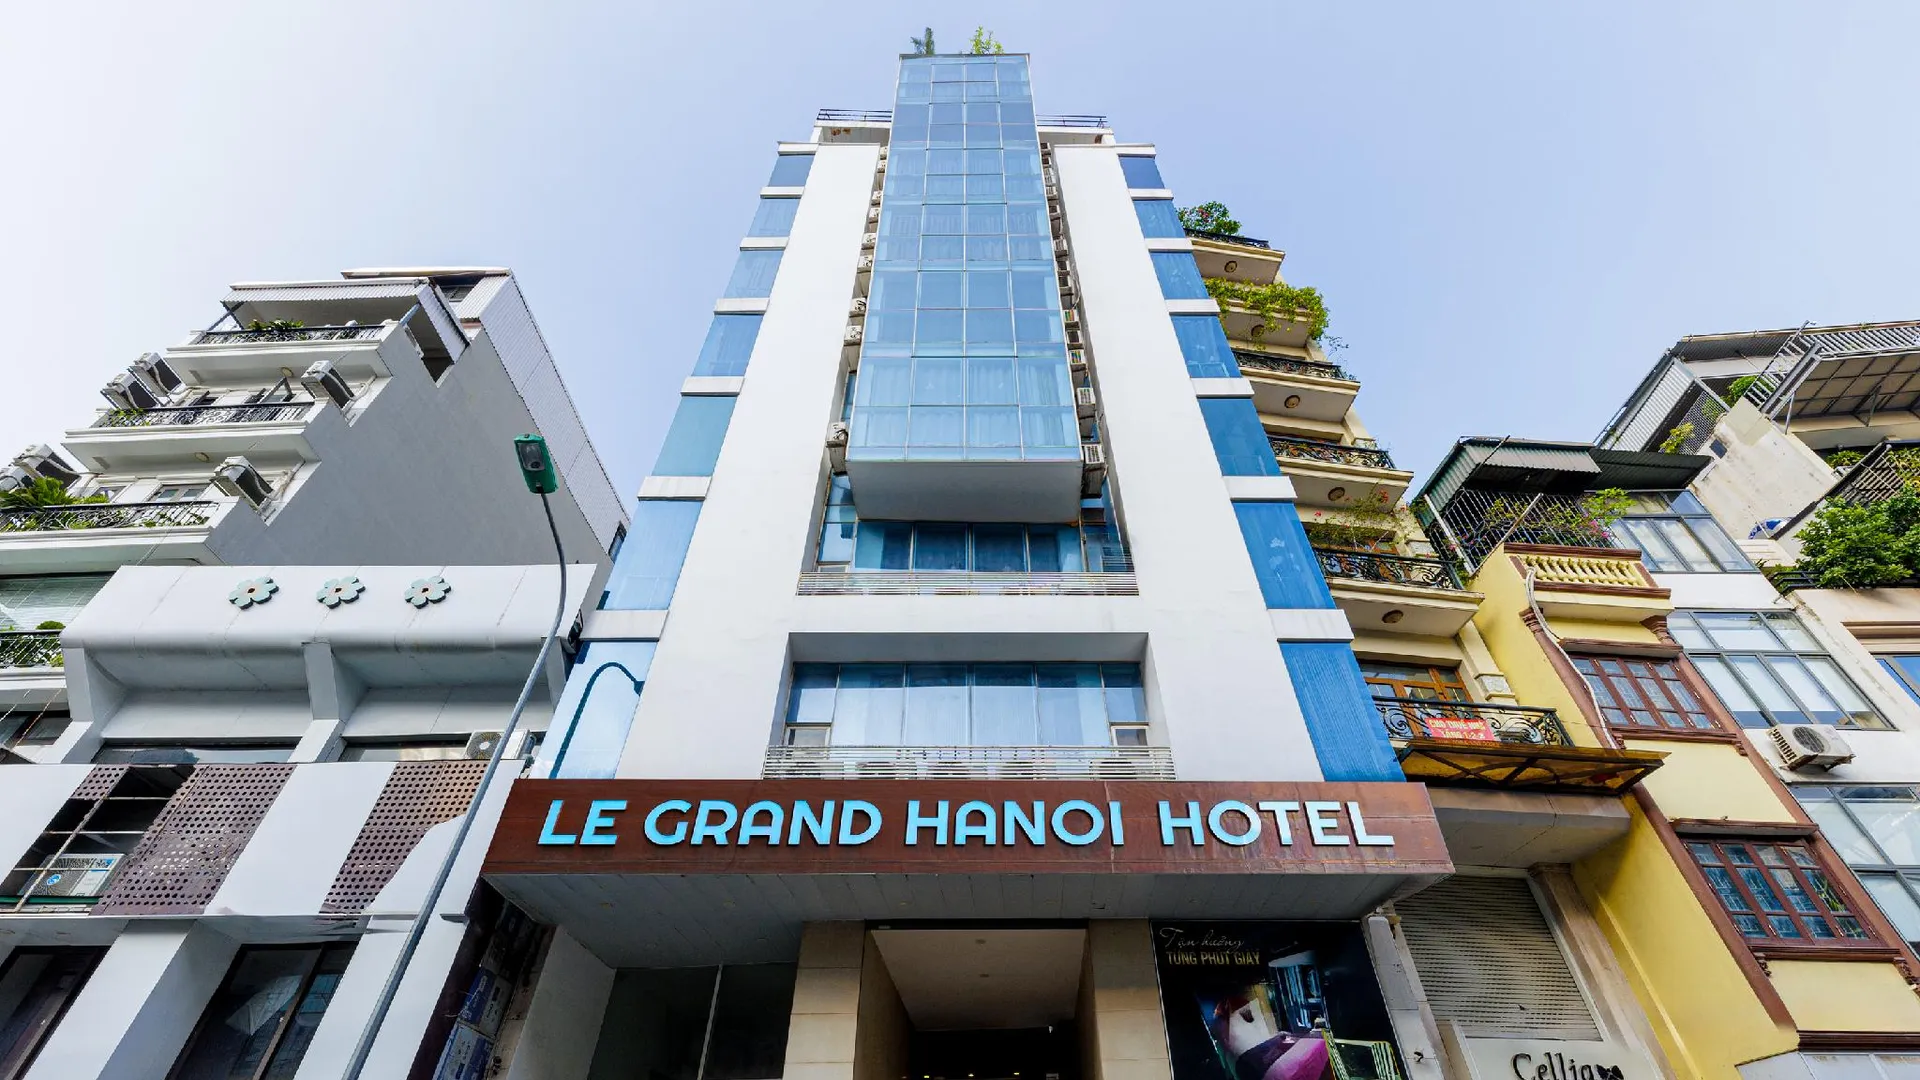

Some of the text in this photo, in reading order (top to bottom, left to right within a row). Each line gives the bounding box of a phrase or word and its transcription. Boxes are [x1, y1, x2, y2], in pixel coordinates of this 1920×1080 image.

[538, 799, 1395, 846] LE GRAND HANOI HOTEL
